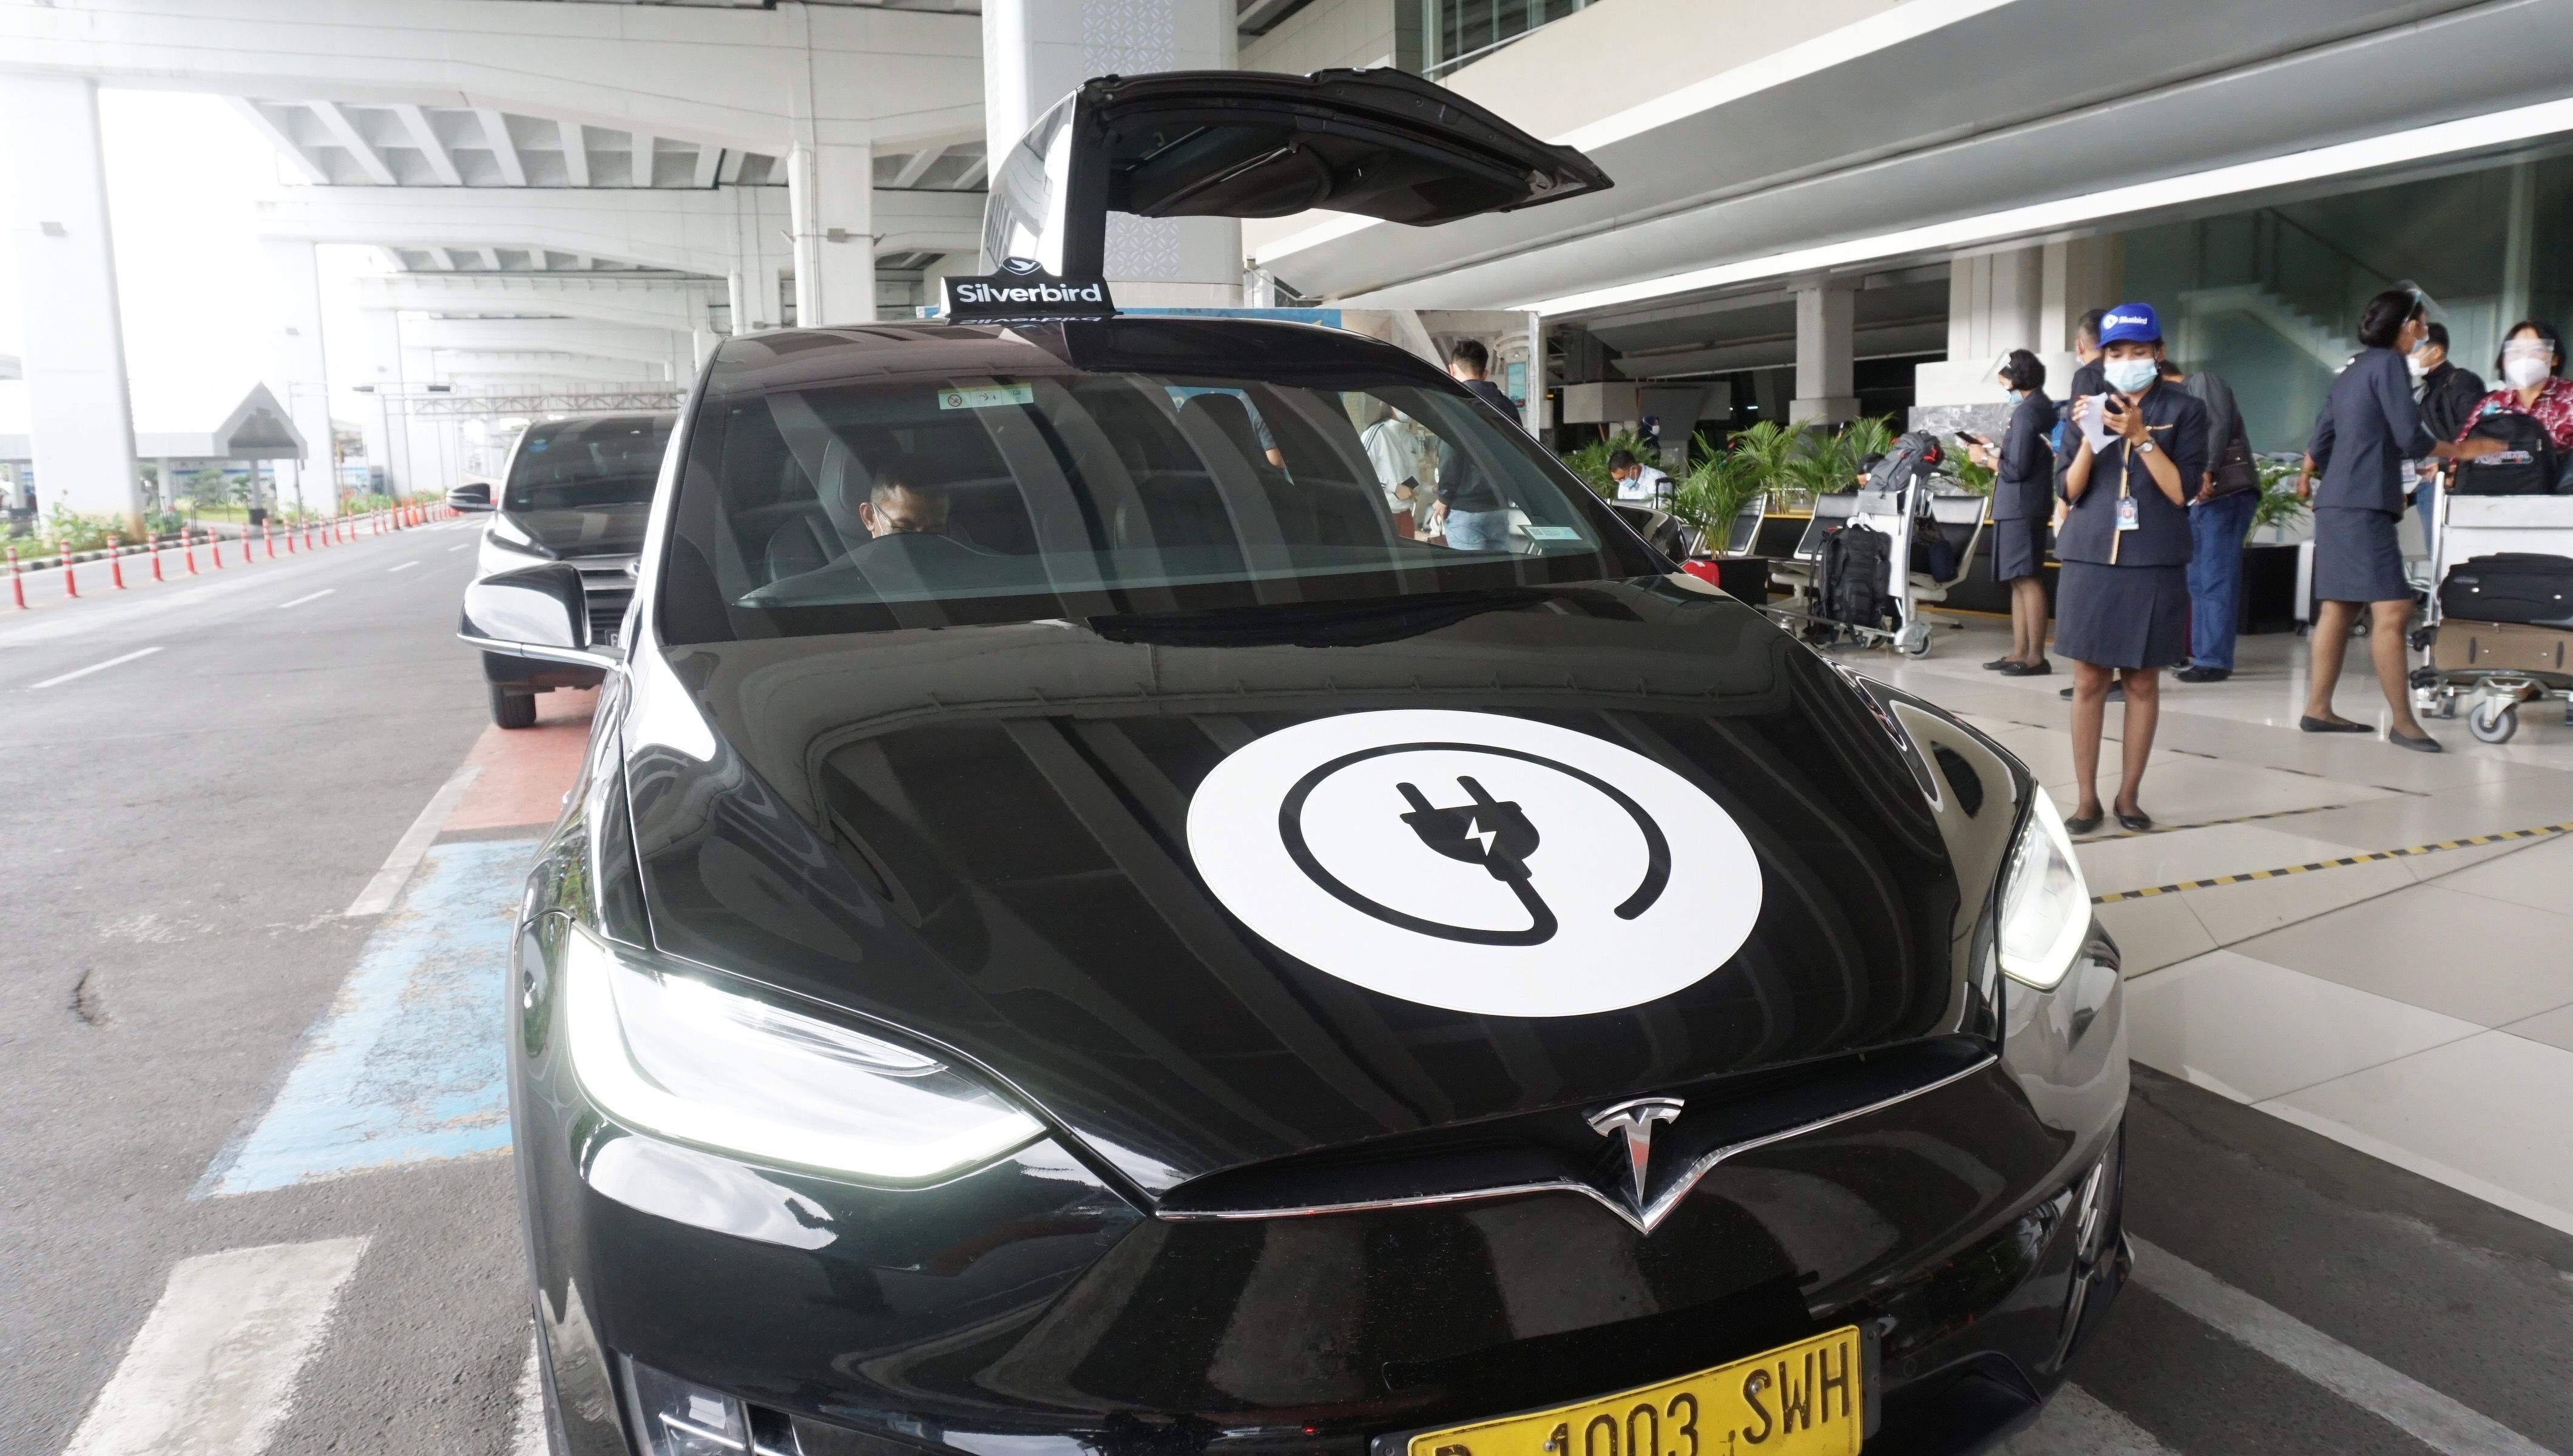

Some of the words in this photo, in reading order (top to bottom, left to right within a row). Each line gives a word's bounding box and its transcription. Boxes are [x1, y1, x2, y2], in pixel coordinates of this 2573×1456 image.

[956, 283, 1102, 302] Silverbird
[2118, 316, 2148, 325] Bluebird
[1743, 1342, 1849, 1444] SWH
